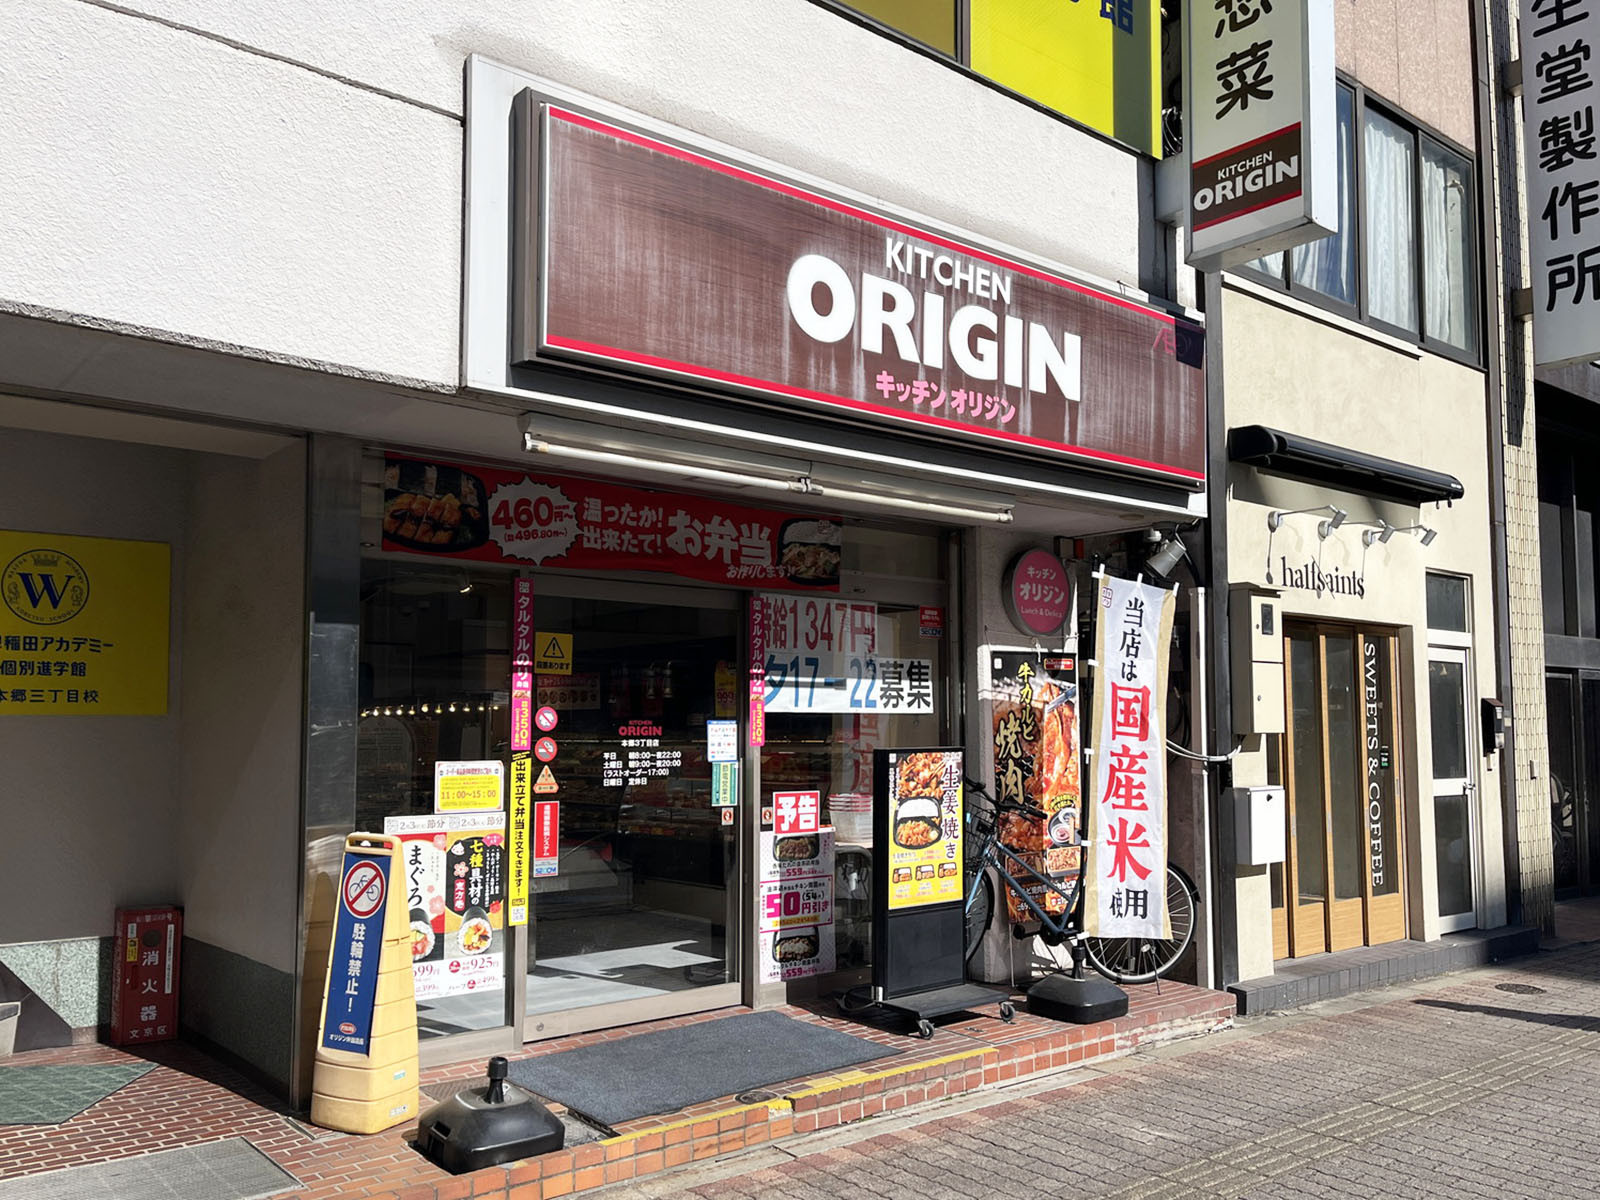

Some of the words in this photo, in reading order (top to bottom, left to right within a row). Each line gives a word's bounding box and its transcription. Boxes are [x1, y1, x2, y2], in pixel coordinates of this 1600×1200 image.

[1193, 155, 1299, 212] ORIGIN
[1216, 151, 1273, 181] KITCHEN
[885, 237, 1012, 304] KITCHEN
[786, 254, 1081, 402] ORIGIN
[666, 509, 773, 566] お弁当
[17, 572, 75, 610] W
[1019, 582, 1065, 604] オリジン
[1026, 565, 1057, 580] キッチン
[1281, 556, 1365, 597] halfsaints
[0, 635, 114, 653] 稲田アカデミー
[1017, 661, 1036, 741] 牛カルビ
[1364, 641, 1380, 750] SWEETS
[618, 726, 663, 737] ORIGIN
[995, 709, 1024, 806] 焼肉
[1101, 597, 1153, 920] 当店は国産米使用
[603, 760, 623, 769] 土曜日
[603, 778, 623, 787] 日曜日
[1367, 757, 1380, 776] &
[776, 795, 817, 832] 予告
[941, 764, 960, 860] 生姜焼き
[1368, 783, 1385, 887] COFFEE
[407, 844, 425, 907] まぐろ
[468, 839, 484, 906] 七種具材の
[140, 949, 159, 1022] 消火器
[344, 922, 367, 1013] 駐輪禁止!
[128, 1025, 168, 1039] 文京区
